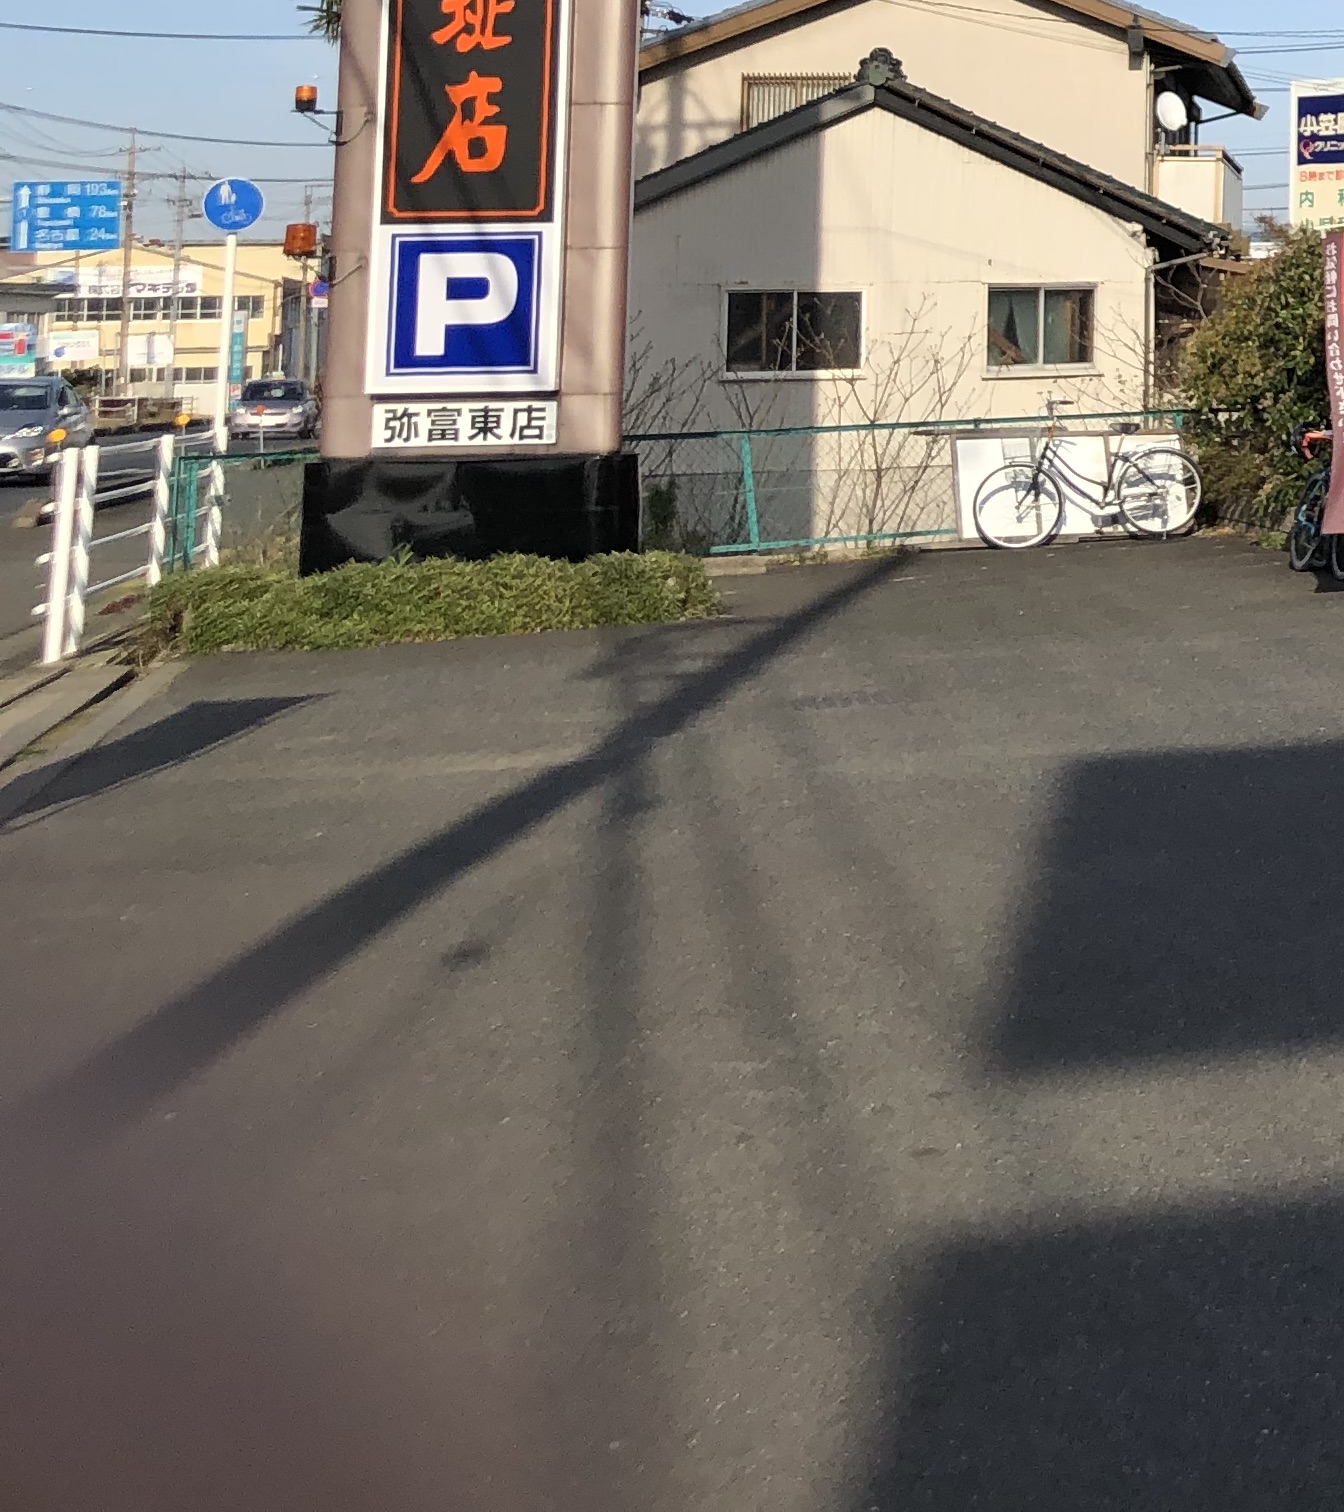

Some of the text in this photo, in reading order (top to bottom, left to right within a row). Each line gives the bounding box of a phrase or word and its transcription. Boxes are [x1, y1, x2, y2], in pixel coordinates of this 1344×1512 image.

[413, 251, 519, 357] P
[383, 404, 547, 444] 弥富東店
